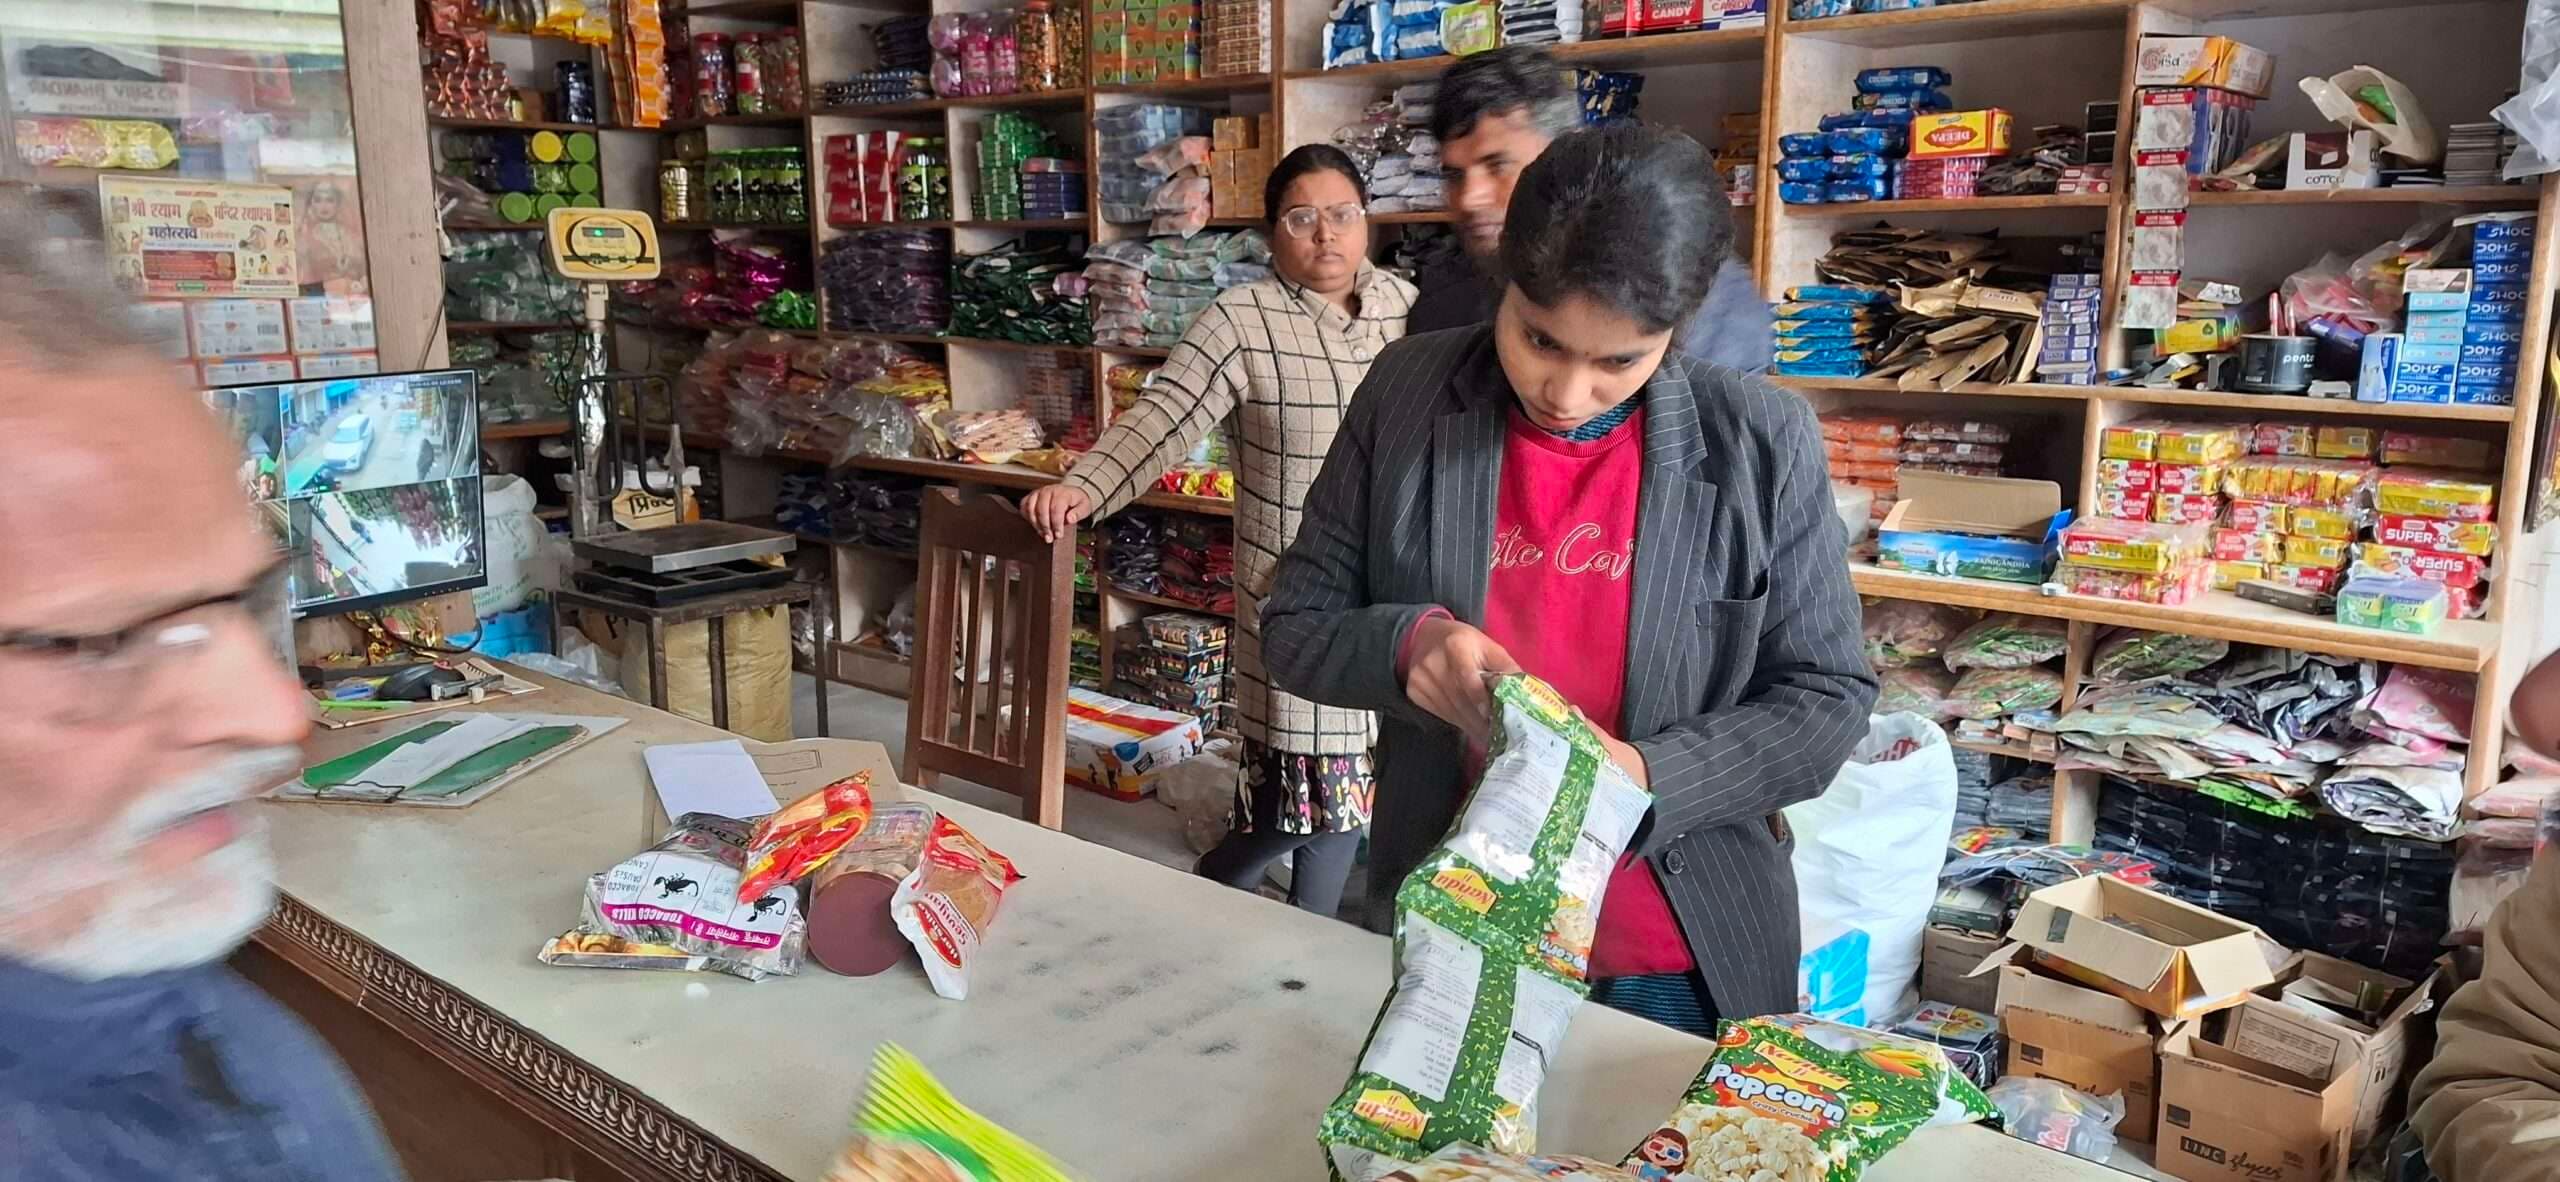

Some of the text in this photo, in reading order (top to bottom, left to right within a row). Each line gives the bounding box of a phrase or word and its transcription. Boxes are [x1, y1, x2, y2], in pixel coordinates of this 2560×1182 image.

[1652, 7, 1693, 20] CANDY
[1931, 128, 1971, 143] DEEPA
[131, 198, 146, 217] श्री
[151, 203, 181, 218] श्याम
[148, 224, 198, 240] महोत्सव
[2477, 243, 2519, 253] DOMS
[2477, 264, 2519, 273] DOMS
[2471, 304, 2512, 313] DOMS
[2464, 345, 2506, 355] DOMS
[2400, 364, 2443, 374] DOMS
[2460, 366, 2503, 376] DOMS
[2397, 384, 2439, 394] DOMS
[1437, 874, 1495, 905] Nandu
[612, 907, 683, 925] TOBACCO KILLS
[1705, 1063, 1847, 1122] Popcorn
[1359, 1101, 1426, 1131] Nandu
[2183, 1140, 2223, 1160] LINC
